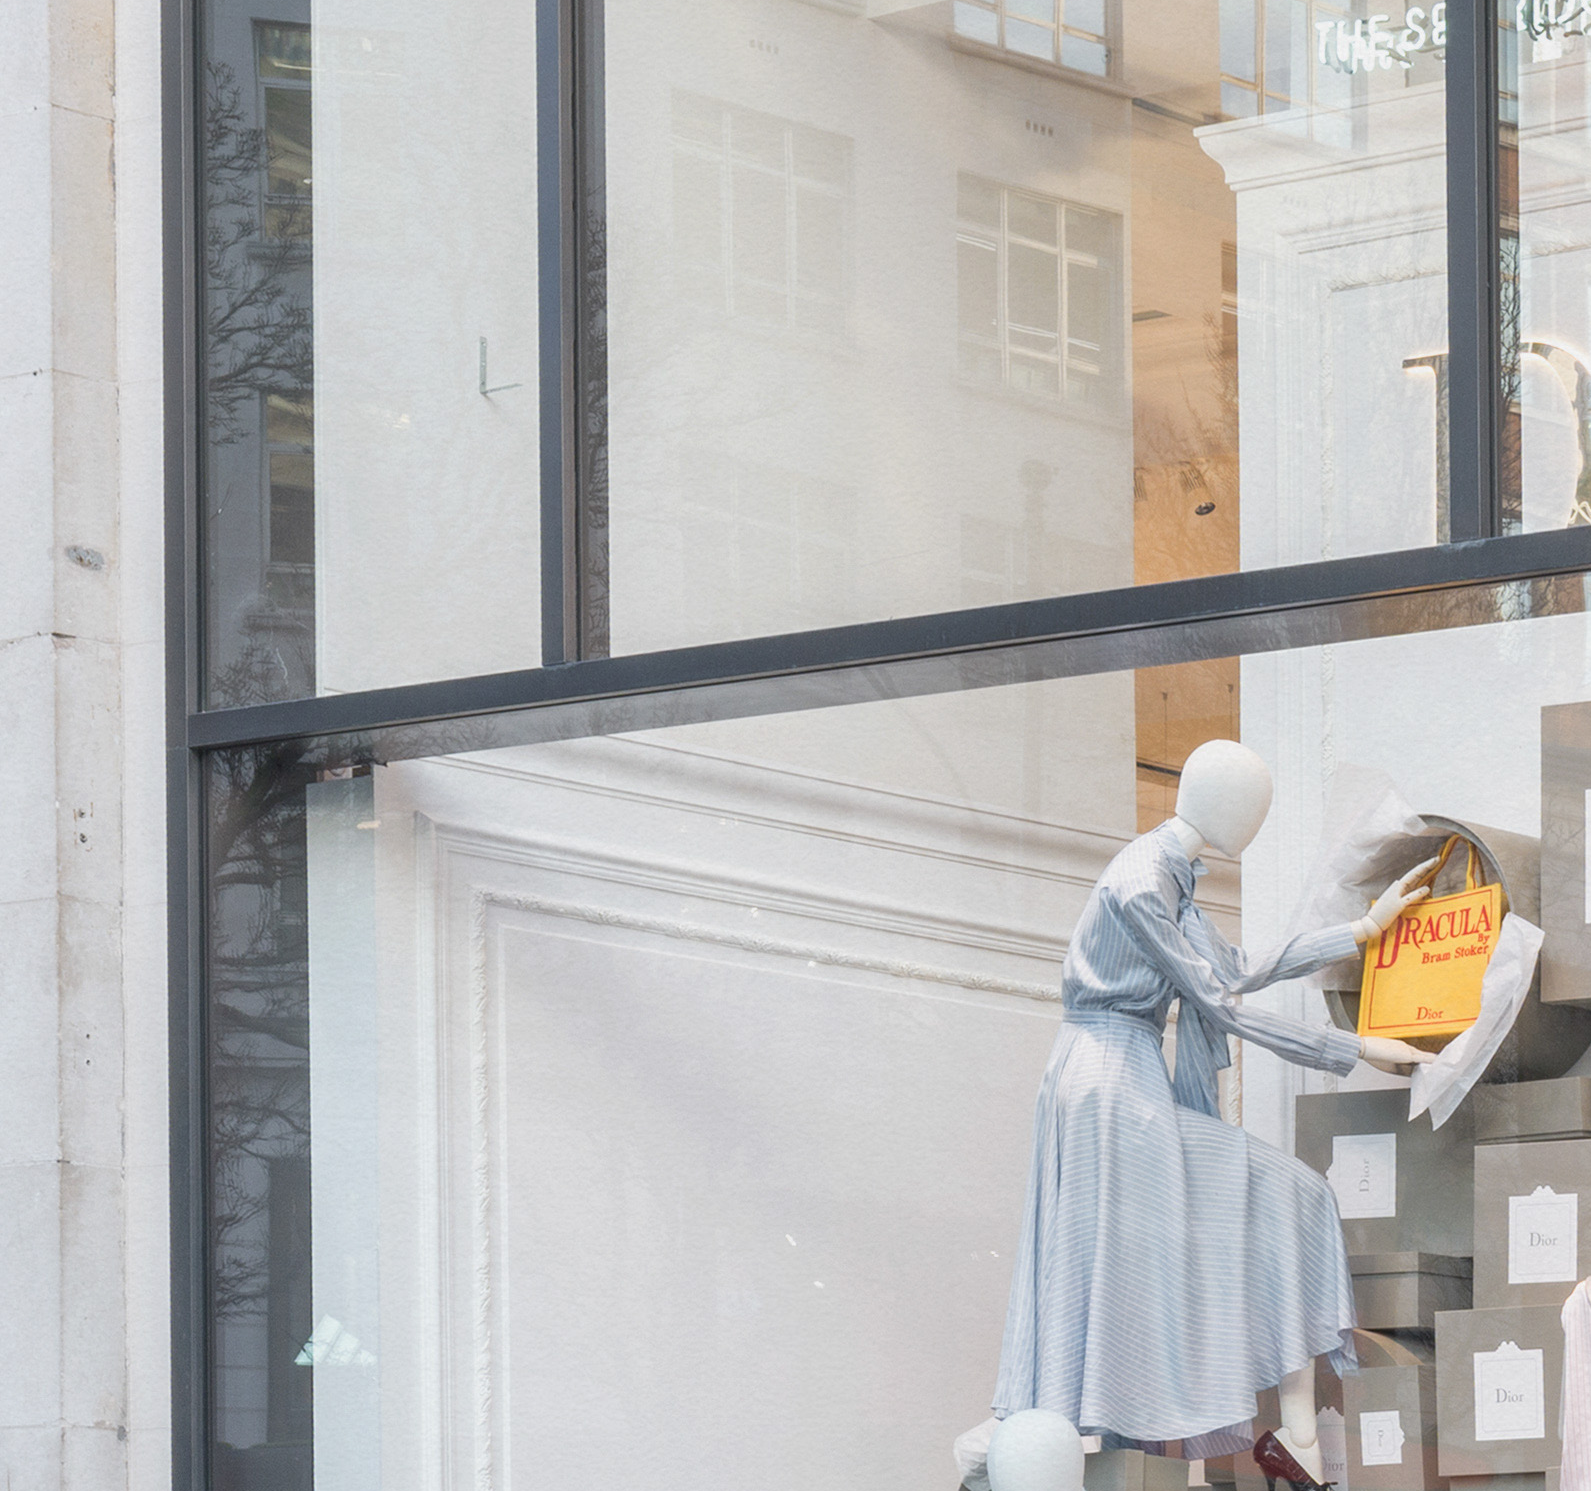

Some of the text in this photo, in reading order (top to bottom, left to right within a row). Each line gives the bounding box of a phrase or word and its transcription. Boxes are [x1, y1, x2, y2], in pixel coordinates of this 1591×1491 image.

[1375, 905, 1492, 970] DRACULA
[1478, 933, 1490, 945] By
[1422, 944, 1489, 964] Bram Stoker
[1415, 1006, 1444, 1021] Dior
[1359, 1158, 1370, 1193] Dior
[1528, 1232, 1559, 1248] Dior
[1496, 1387, 1525, 1404] Dior
